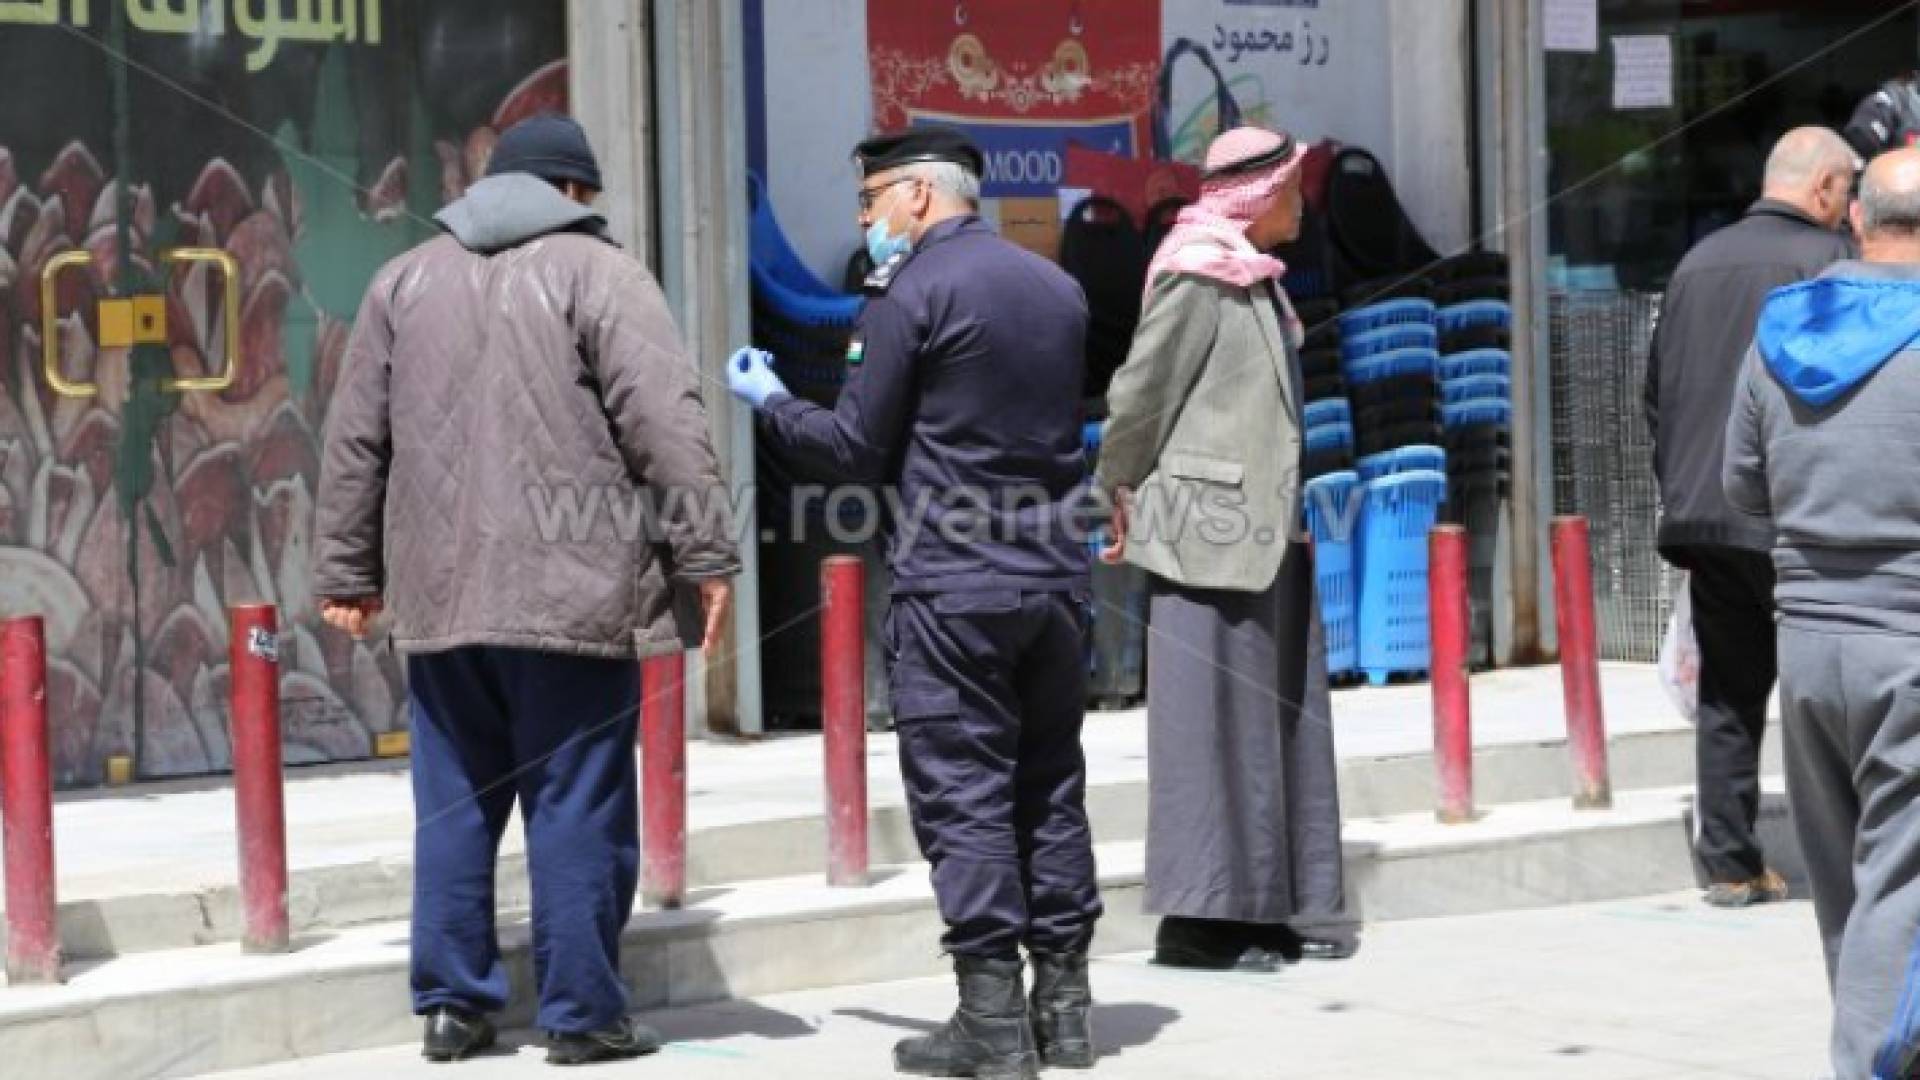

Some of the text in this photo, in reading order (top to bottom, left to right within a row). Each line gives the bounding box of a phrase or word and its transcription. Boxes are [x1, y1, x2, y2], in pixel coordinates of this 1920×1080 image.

[1212, 20, 1329, 66] رز محمود
[982, 150, 1061, 183] MOOD
